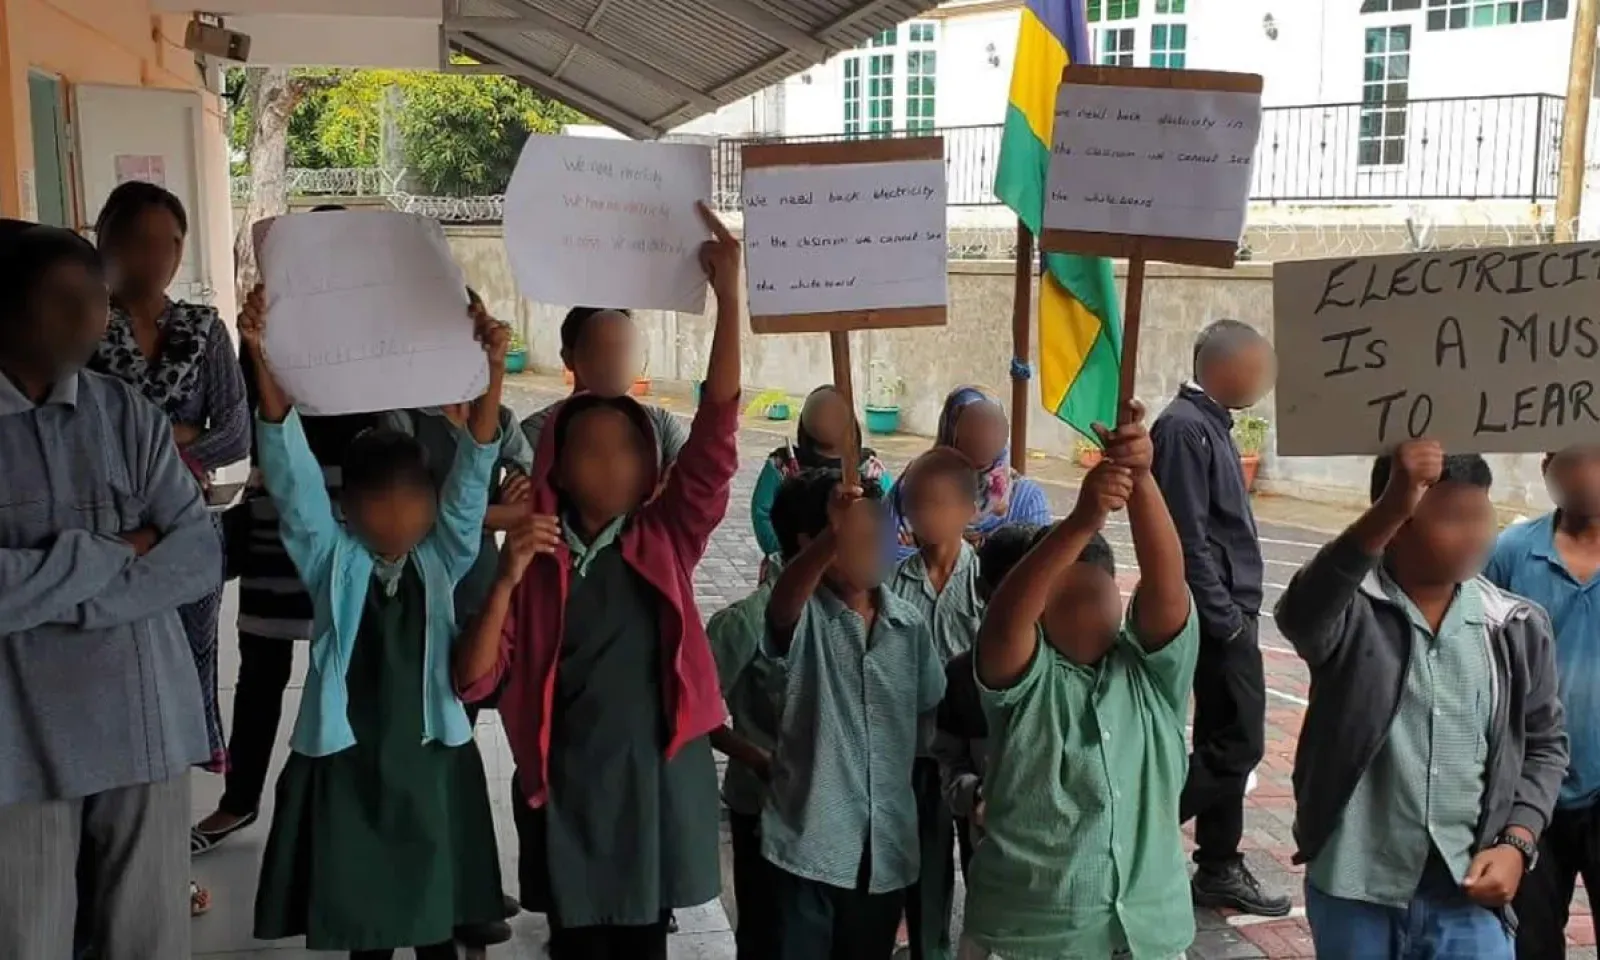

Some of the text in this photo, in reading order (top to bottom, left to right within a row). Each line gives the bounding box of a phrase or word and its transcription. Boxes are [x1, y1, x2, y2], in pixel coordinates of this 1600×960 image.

[1434, 315, 1467, 370] A
[1498, 312, 1600, 364] MUS
[1367, 379, 1600, 443] TO LEAR
